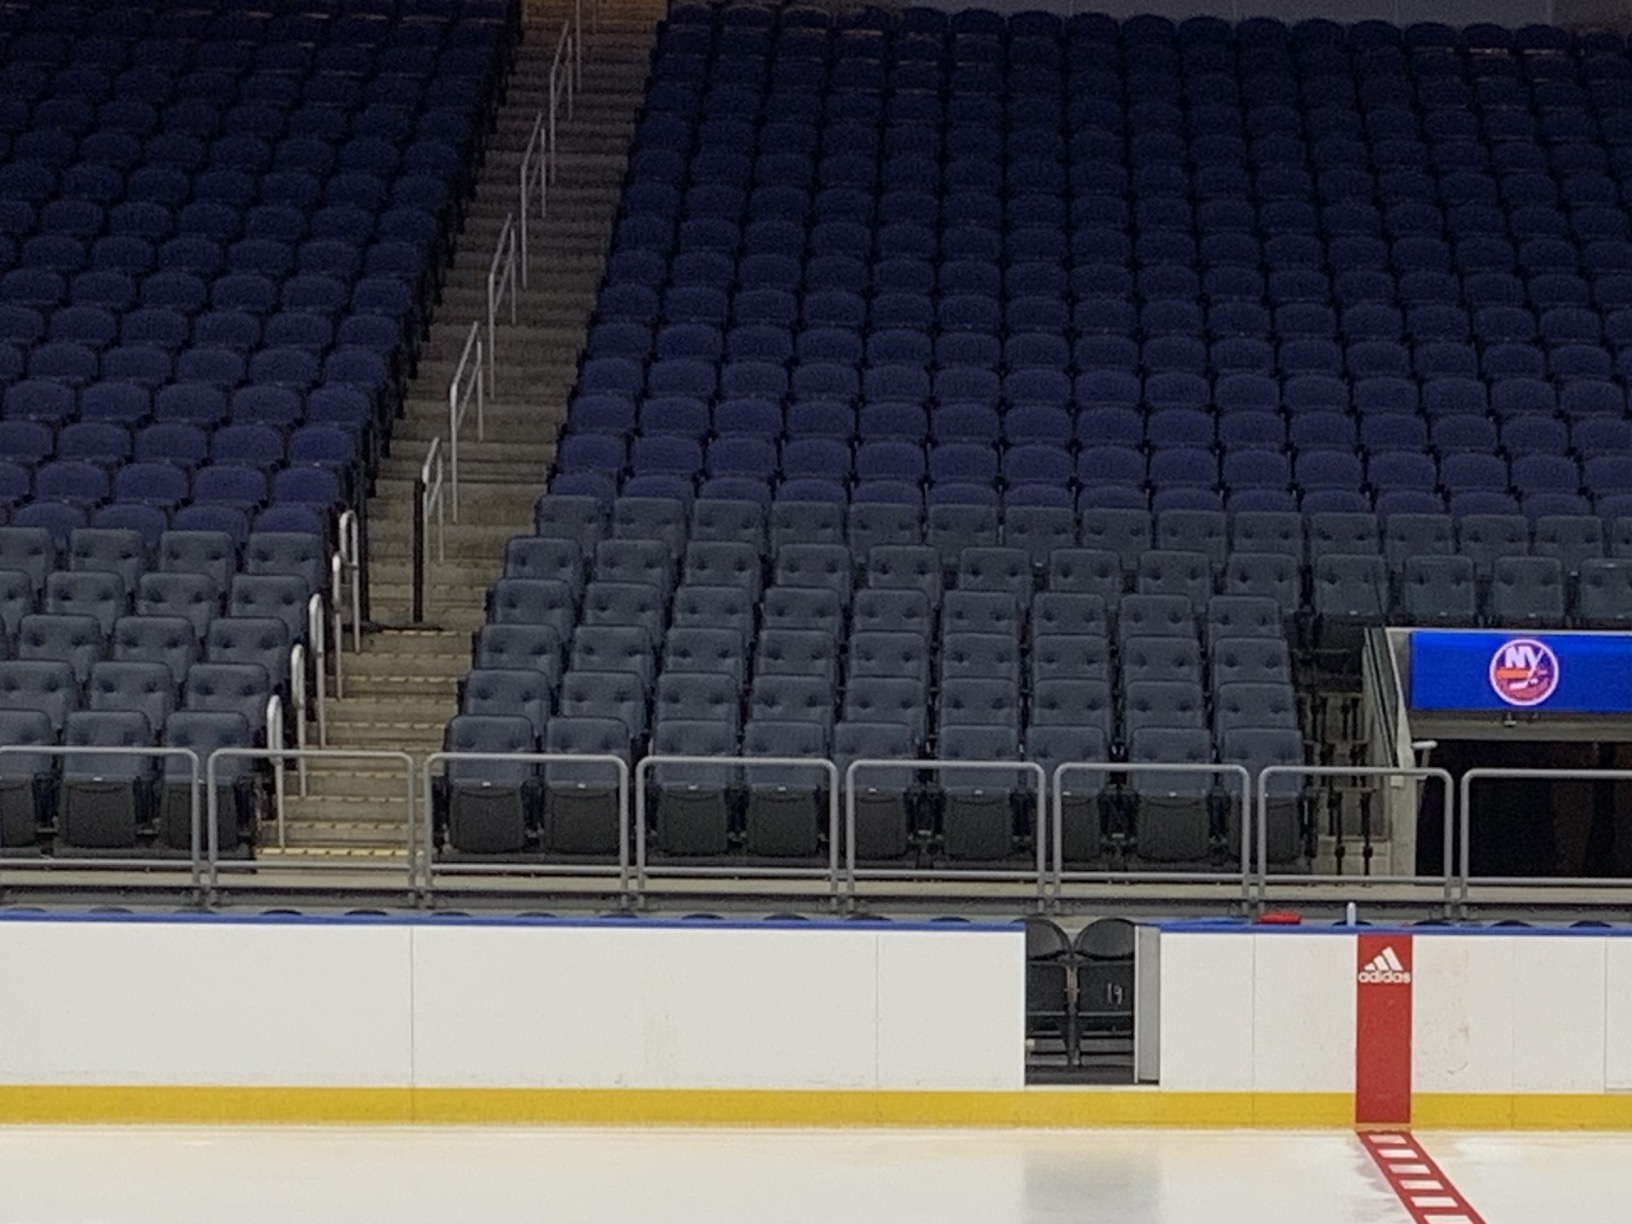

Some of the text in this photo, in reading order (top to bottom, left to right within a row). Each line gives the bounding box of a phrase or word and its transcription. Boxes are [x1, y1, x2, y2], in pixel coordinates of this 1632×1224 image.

[1505, 645, 1544, 675] NY
[1358, 970, 1411, 984] adidas
[1107, 982, 1123, 1005] 19
